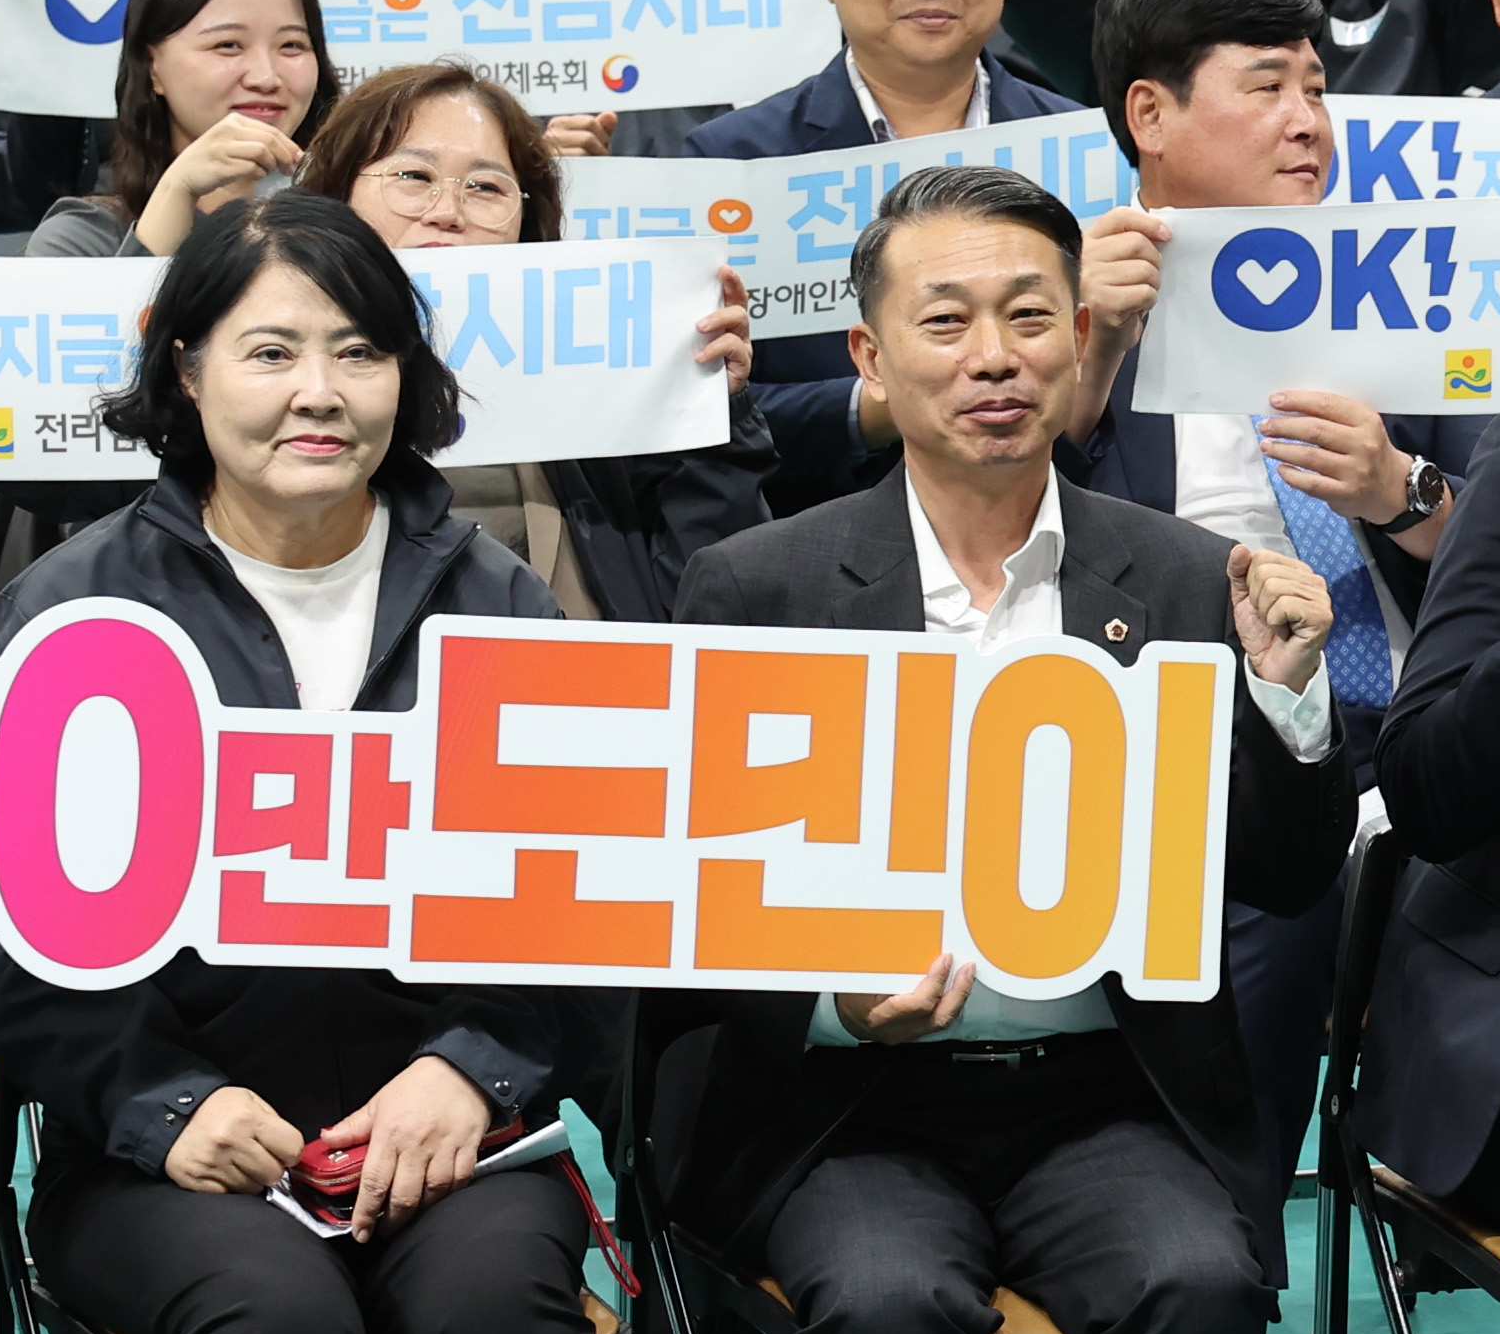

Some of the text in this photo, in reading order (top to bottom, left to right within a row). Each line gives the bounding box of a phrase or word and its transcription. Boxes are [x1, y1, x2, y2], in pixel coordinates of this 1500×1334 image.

[1328, 120, 1461, 203] K!
[420, 261, 652, 378] 시대
[1212, 226, 1457, 332] OK!
